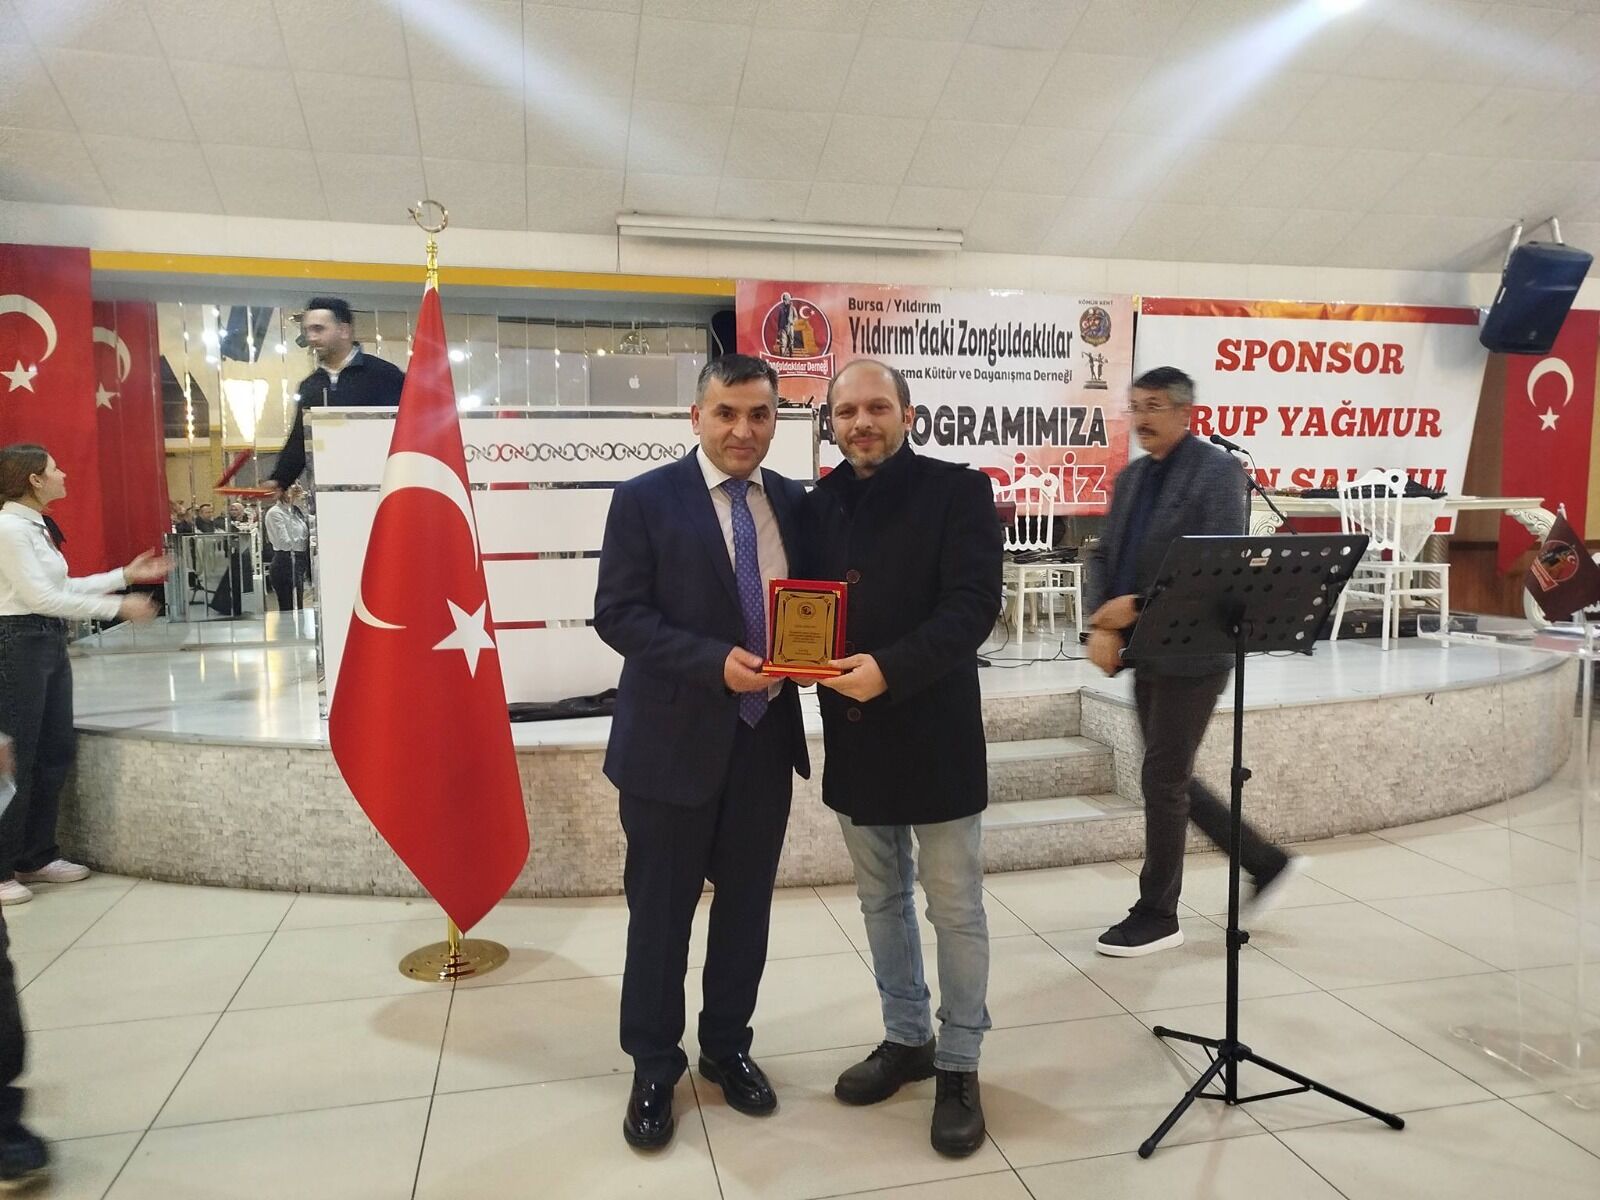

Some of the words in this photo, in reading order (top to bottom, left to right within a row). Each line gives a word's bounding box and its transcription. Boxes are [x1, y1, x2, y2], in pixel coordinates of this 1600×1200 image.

[848, 297, 884, 311] Bursa
[886, 298, 892, 313] /
[894, 299, 941, 314] Yıldırım
[848, 316, 955, 356] Yıldırım'daki
[957, 320, 1073, 367] Zonguldaklılar
[1215, 338, 1405, 375] SPONSOR
[925, 366, 957, 380] Kültür
[959, 370, 972, 380] ve
[974, 368, 1032, 383] Dayanışma
[1034, 369, 1072, 384] Derneği
[911, 404, 1108, 447] OGRAMIMIZA
[1189, 405, 1268, 437] RUP
[1278, 400, 1442, 438] YAĞMUR
[978, 452, 1107, 504] DİNİZ
